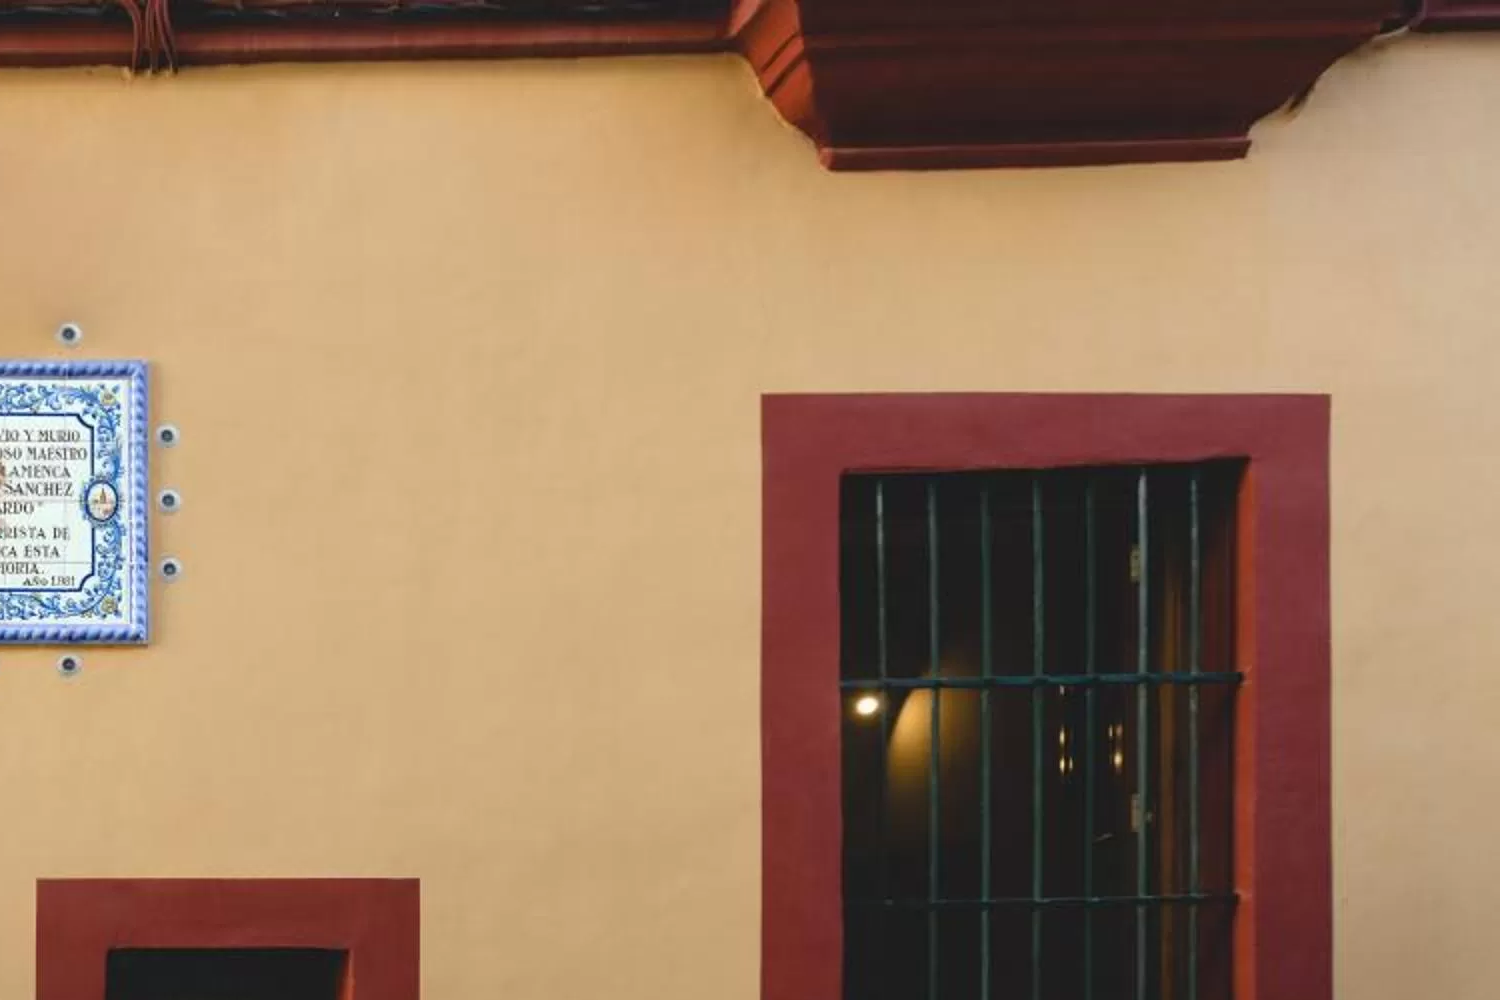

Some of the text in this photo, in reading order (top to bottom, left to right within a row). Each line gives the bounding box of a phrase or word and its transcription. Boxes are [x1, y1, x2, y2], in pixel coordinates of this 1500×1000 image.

[23, 429, 34, 442] Y
[26, 447, 88, 461] MAESTRO
[52, 527, 70, 541] DE
[23, 545, 60, 558] ESTA
